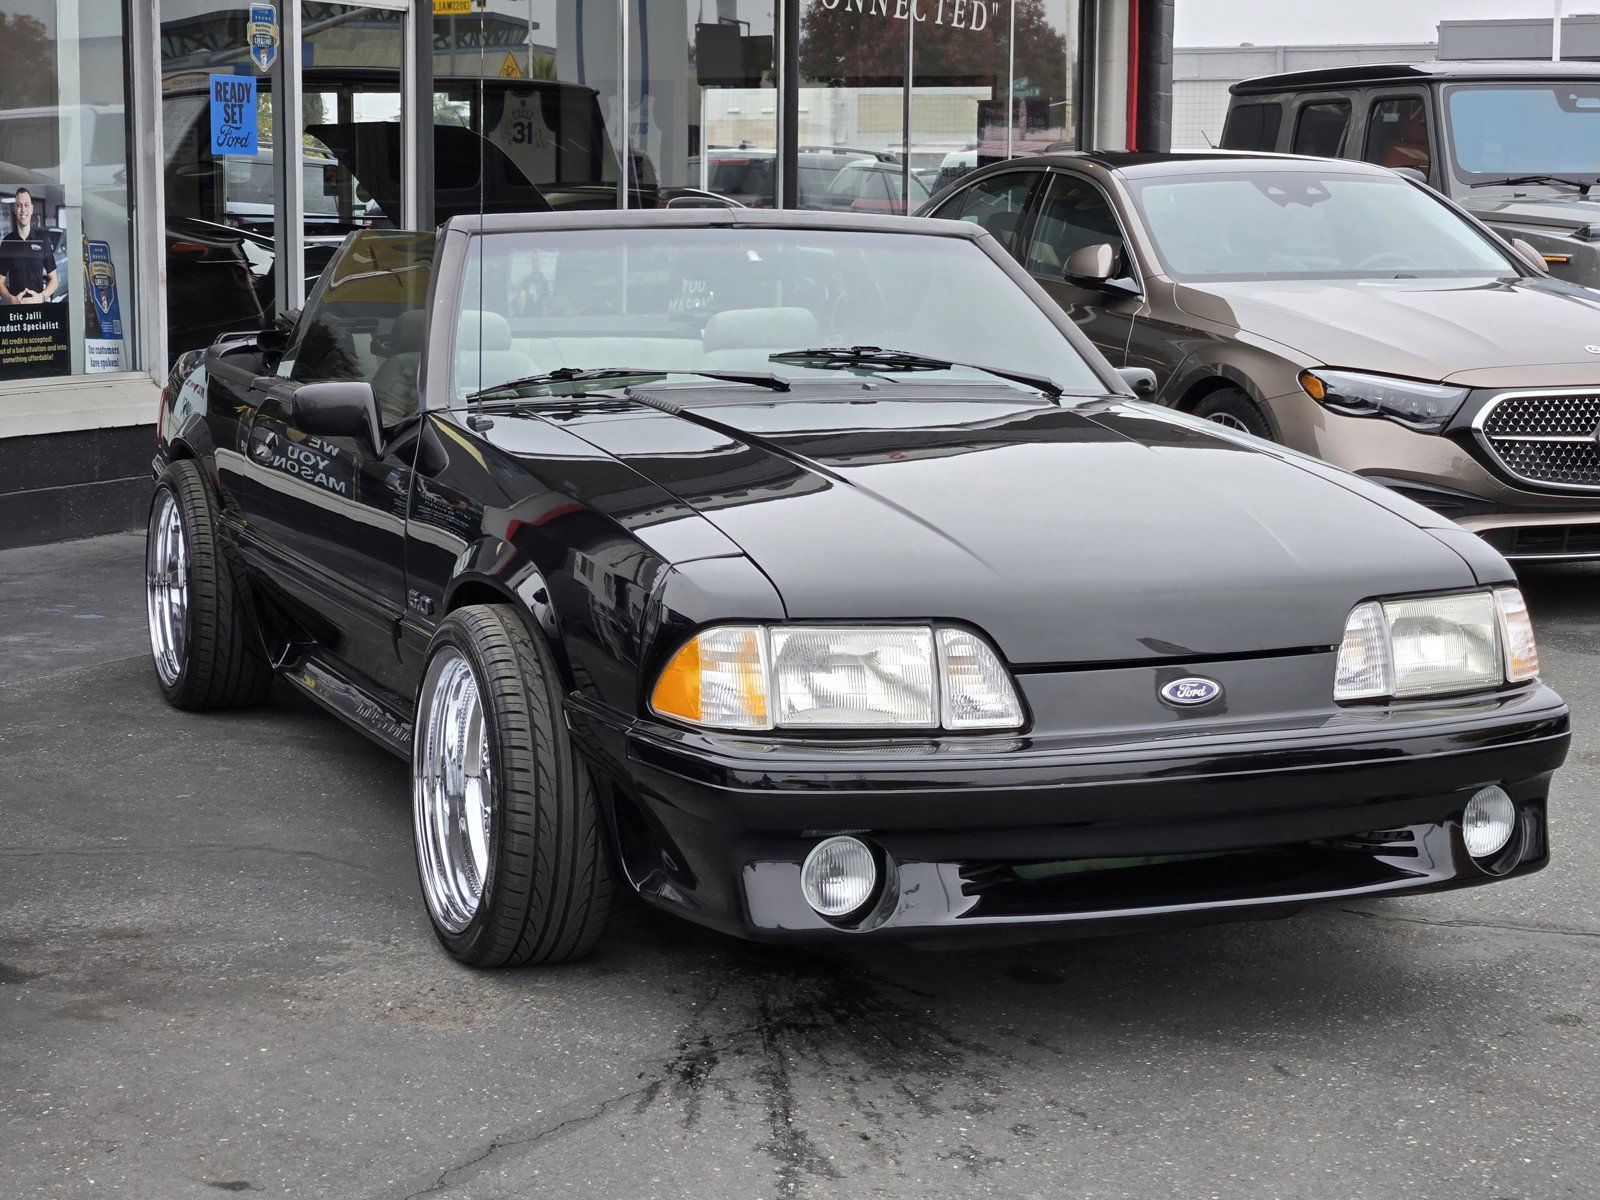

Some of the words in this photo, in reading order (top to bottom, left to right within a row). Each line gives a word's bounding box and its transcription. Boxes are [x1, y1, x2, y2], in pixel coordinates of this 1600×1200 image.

[215, 80, 252, 103] READY
[223, 103, 244, 125] SET
[216, 124, 251, 149] Ford
[512, 121, 533, 145] 31
[9, 312, 24, 321] Eric
[26, 311, 42, 320] Jalli
[0, 323, 21, 333] roduct
[22, 321, 59, 332] Specialist
[1, 338, 9, 346] All
[9, 337, 23, 345] credit
[2, 355, 28, 364] something
[1176, 683, 1207, 698] Ford
